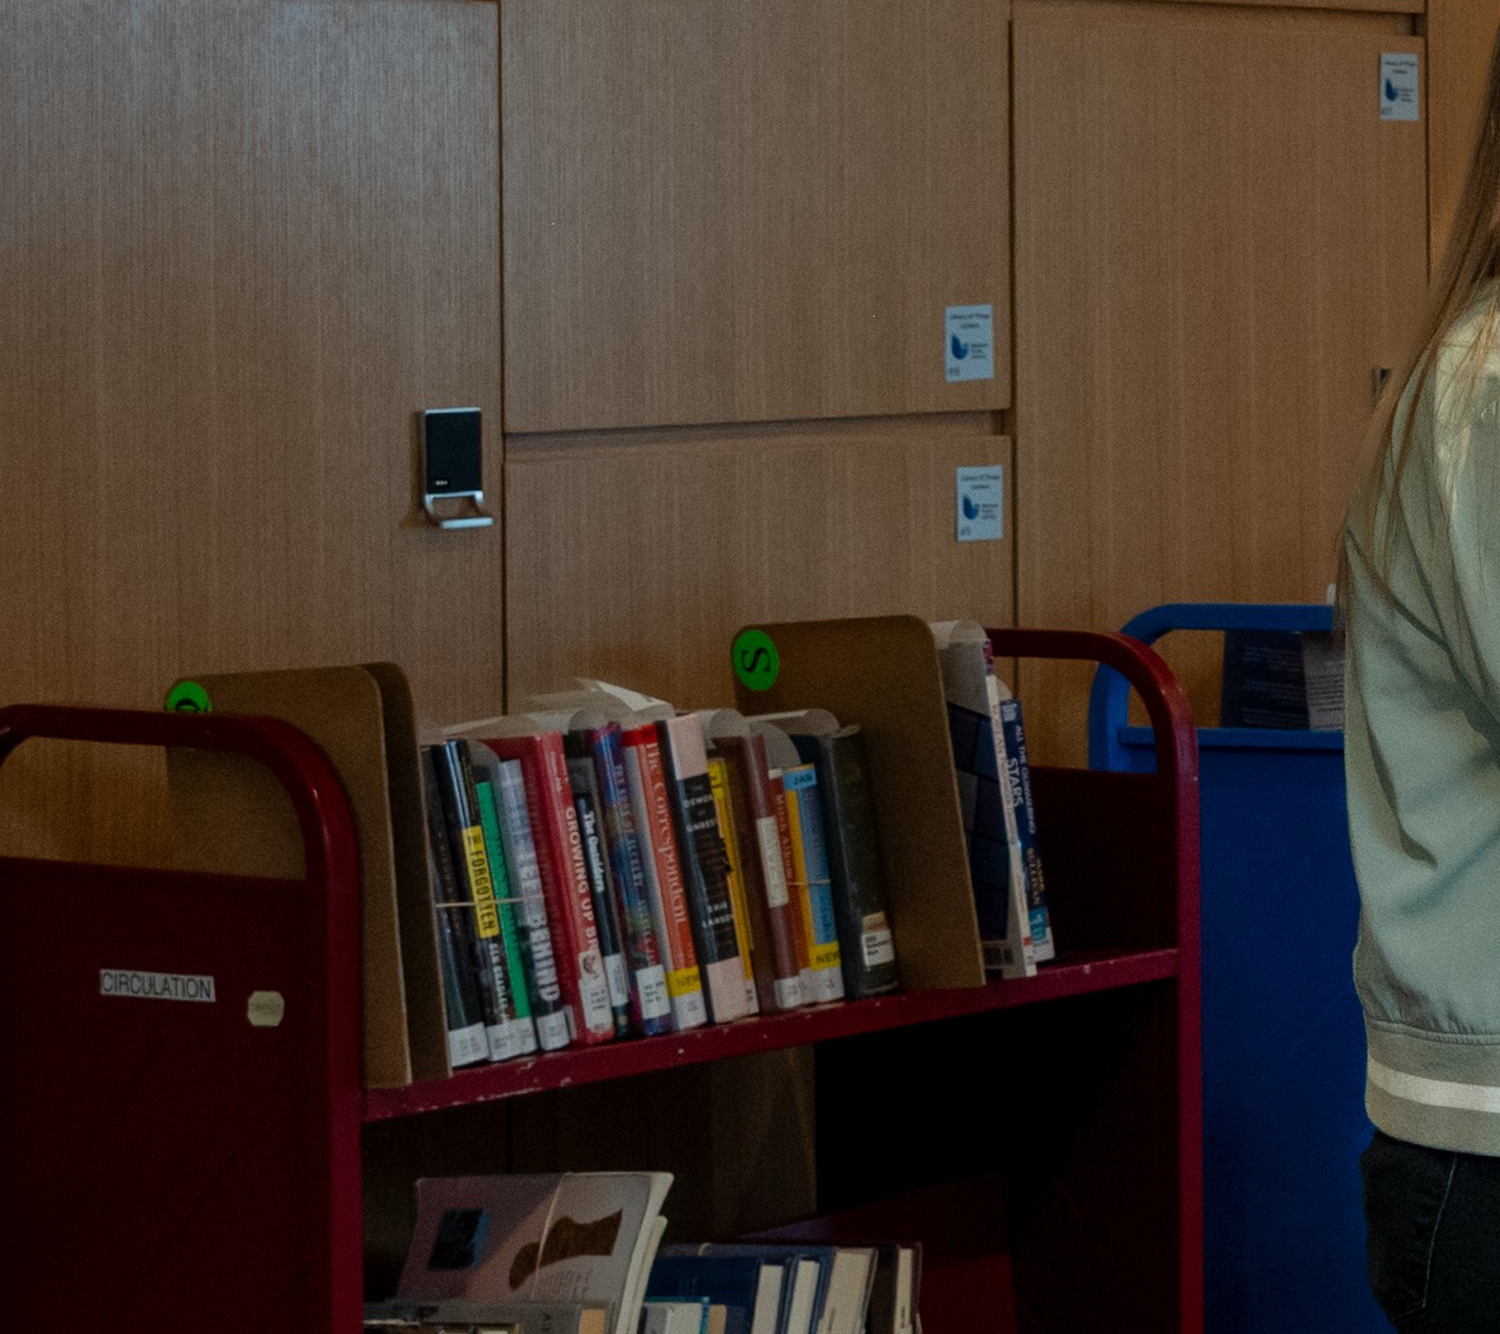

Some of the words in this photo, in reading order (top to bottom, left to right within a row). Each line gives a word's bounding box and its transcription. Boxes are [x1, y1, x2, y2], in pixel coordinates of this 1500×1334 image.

[740, 647, 772, 673] S
[1004, 756, 1026, 807] STARS
[1016, 745, 1027, 764] THE
[582, 809, 597, 835] The
[564, 807, 588, 895] GROWING
[580, 897, 595, 923] UP
[588, 834, 606, 894] Outsiders
[651, 780, 687, 924] Correspondent
[469, 849, 496, 930] FORGOTTEN
[525, 910, 562, 1003] BEHIND
[101, 972, 212, 999] CIRCULATION
